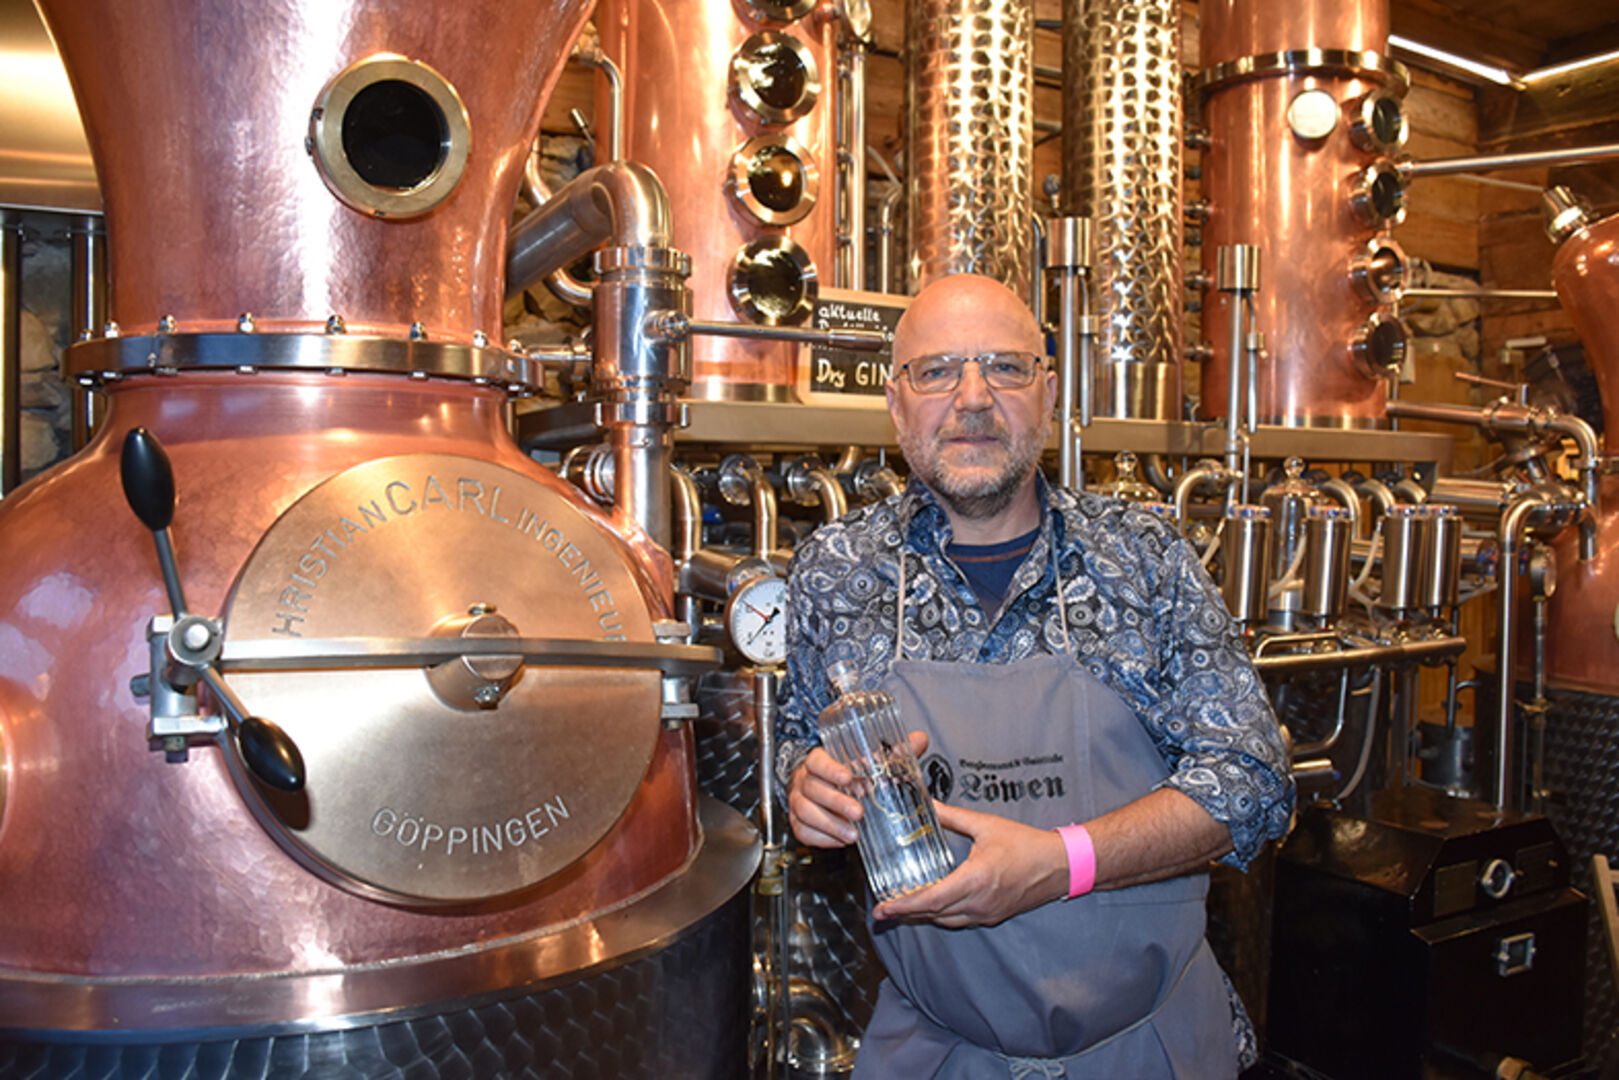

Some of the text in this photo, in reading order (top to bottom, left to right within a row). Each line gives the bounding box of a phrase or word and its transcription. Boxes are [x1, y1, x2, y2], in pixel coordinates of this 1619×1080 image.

[816, 357, 893, 388] Dry GIN
[271, 500, 388, 638] HRISTIAN
[385, 475, 509, 523] CARL
[959, 773, 1065, 802] Löwen
[371, 794, 570, 856] GÖPPINGEN
